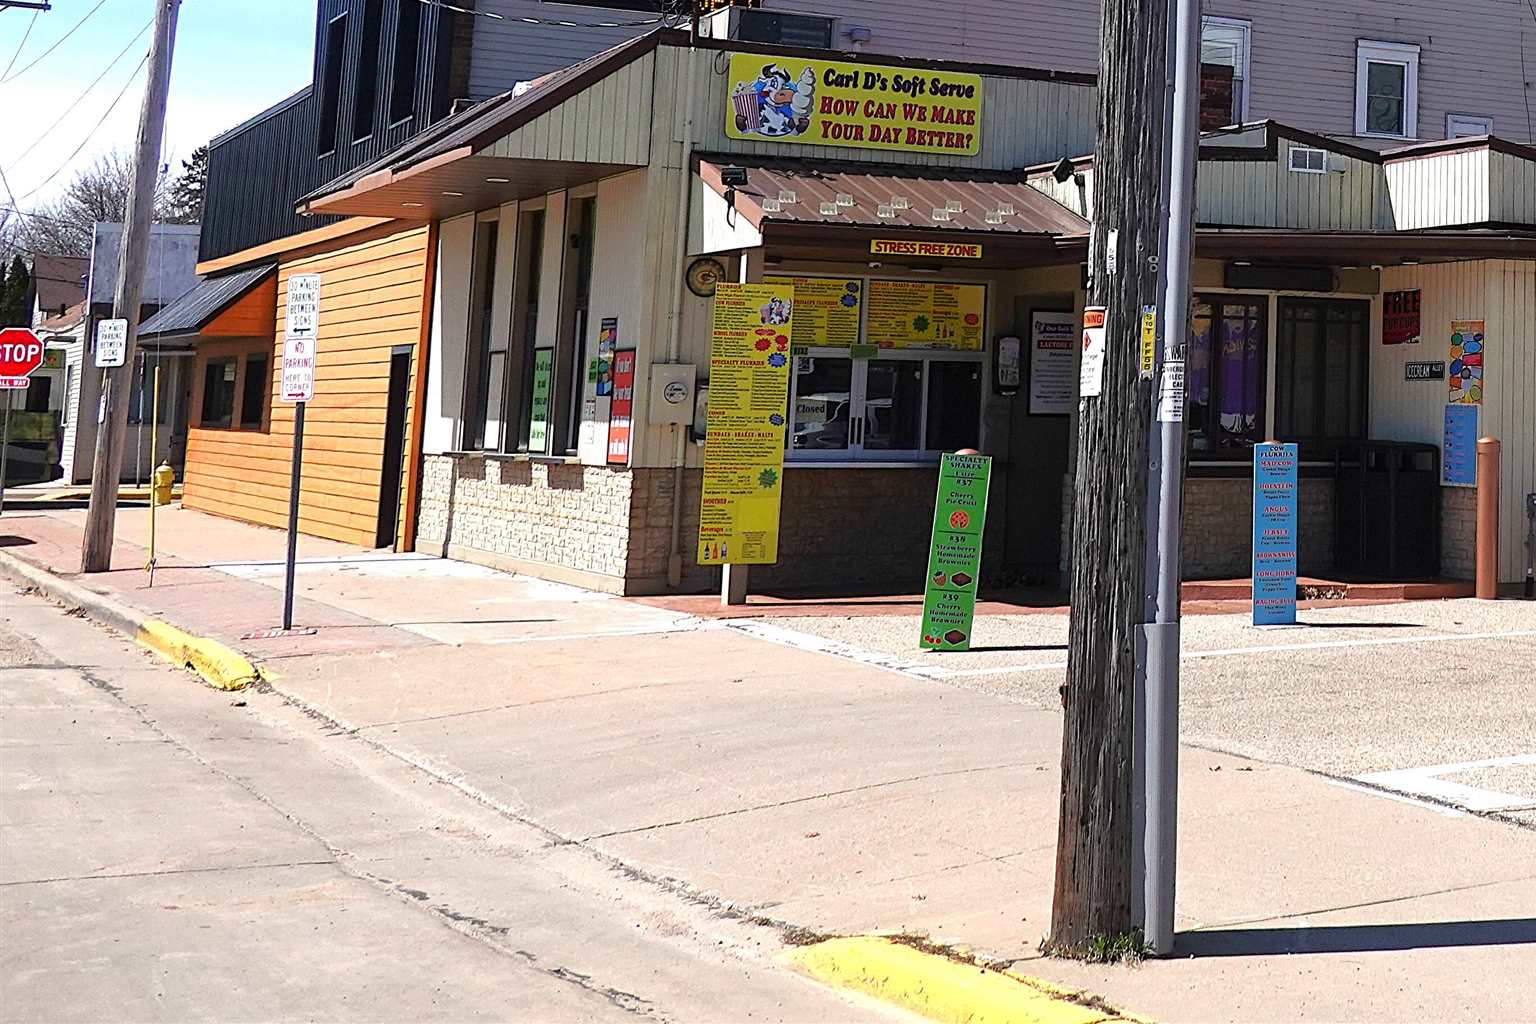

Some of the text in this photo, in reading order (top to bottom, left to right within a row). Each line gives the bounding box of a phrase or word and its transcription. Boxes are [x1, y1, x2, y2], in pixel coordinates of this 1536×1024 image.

[823, 69, 975, 98] Carl D's Soft Serve
[820, 96, 976, 126] HOW CAN WE MAKE
[821, 121, 973, 149] YOUR DAY BETTER?
[875, 241, 977, 257] STRESS FREE ZONE
[291, 292, 315, 302] PARKING
[290, 304, 316, 314] BETWEEN
[0, 344, 39, 362] TOP
[294, 343, 305, 353] NO
[285, 358, 313, 369] PARKING
[797, 404, 825, 414] Closed
[945, 456, 988, 464] SPECIALTY
[936, 544, 976, 552] Strawberry
